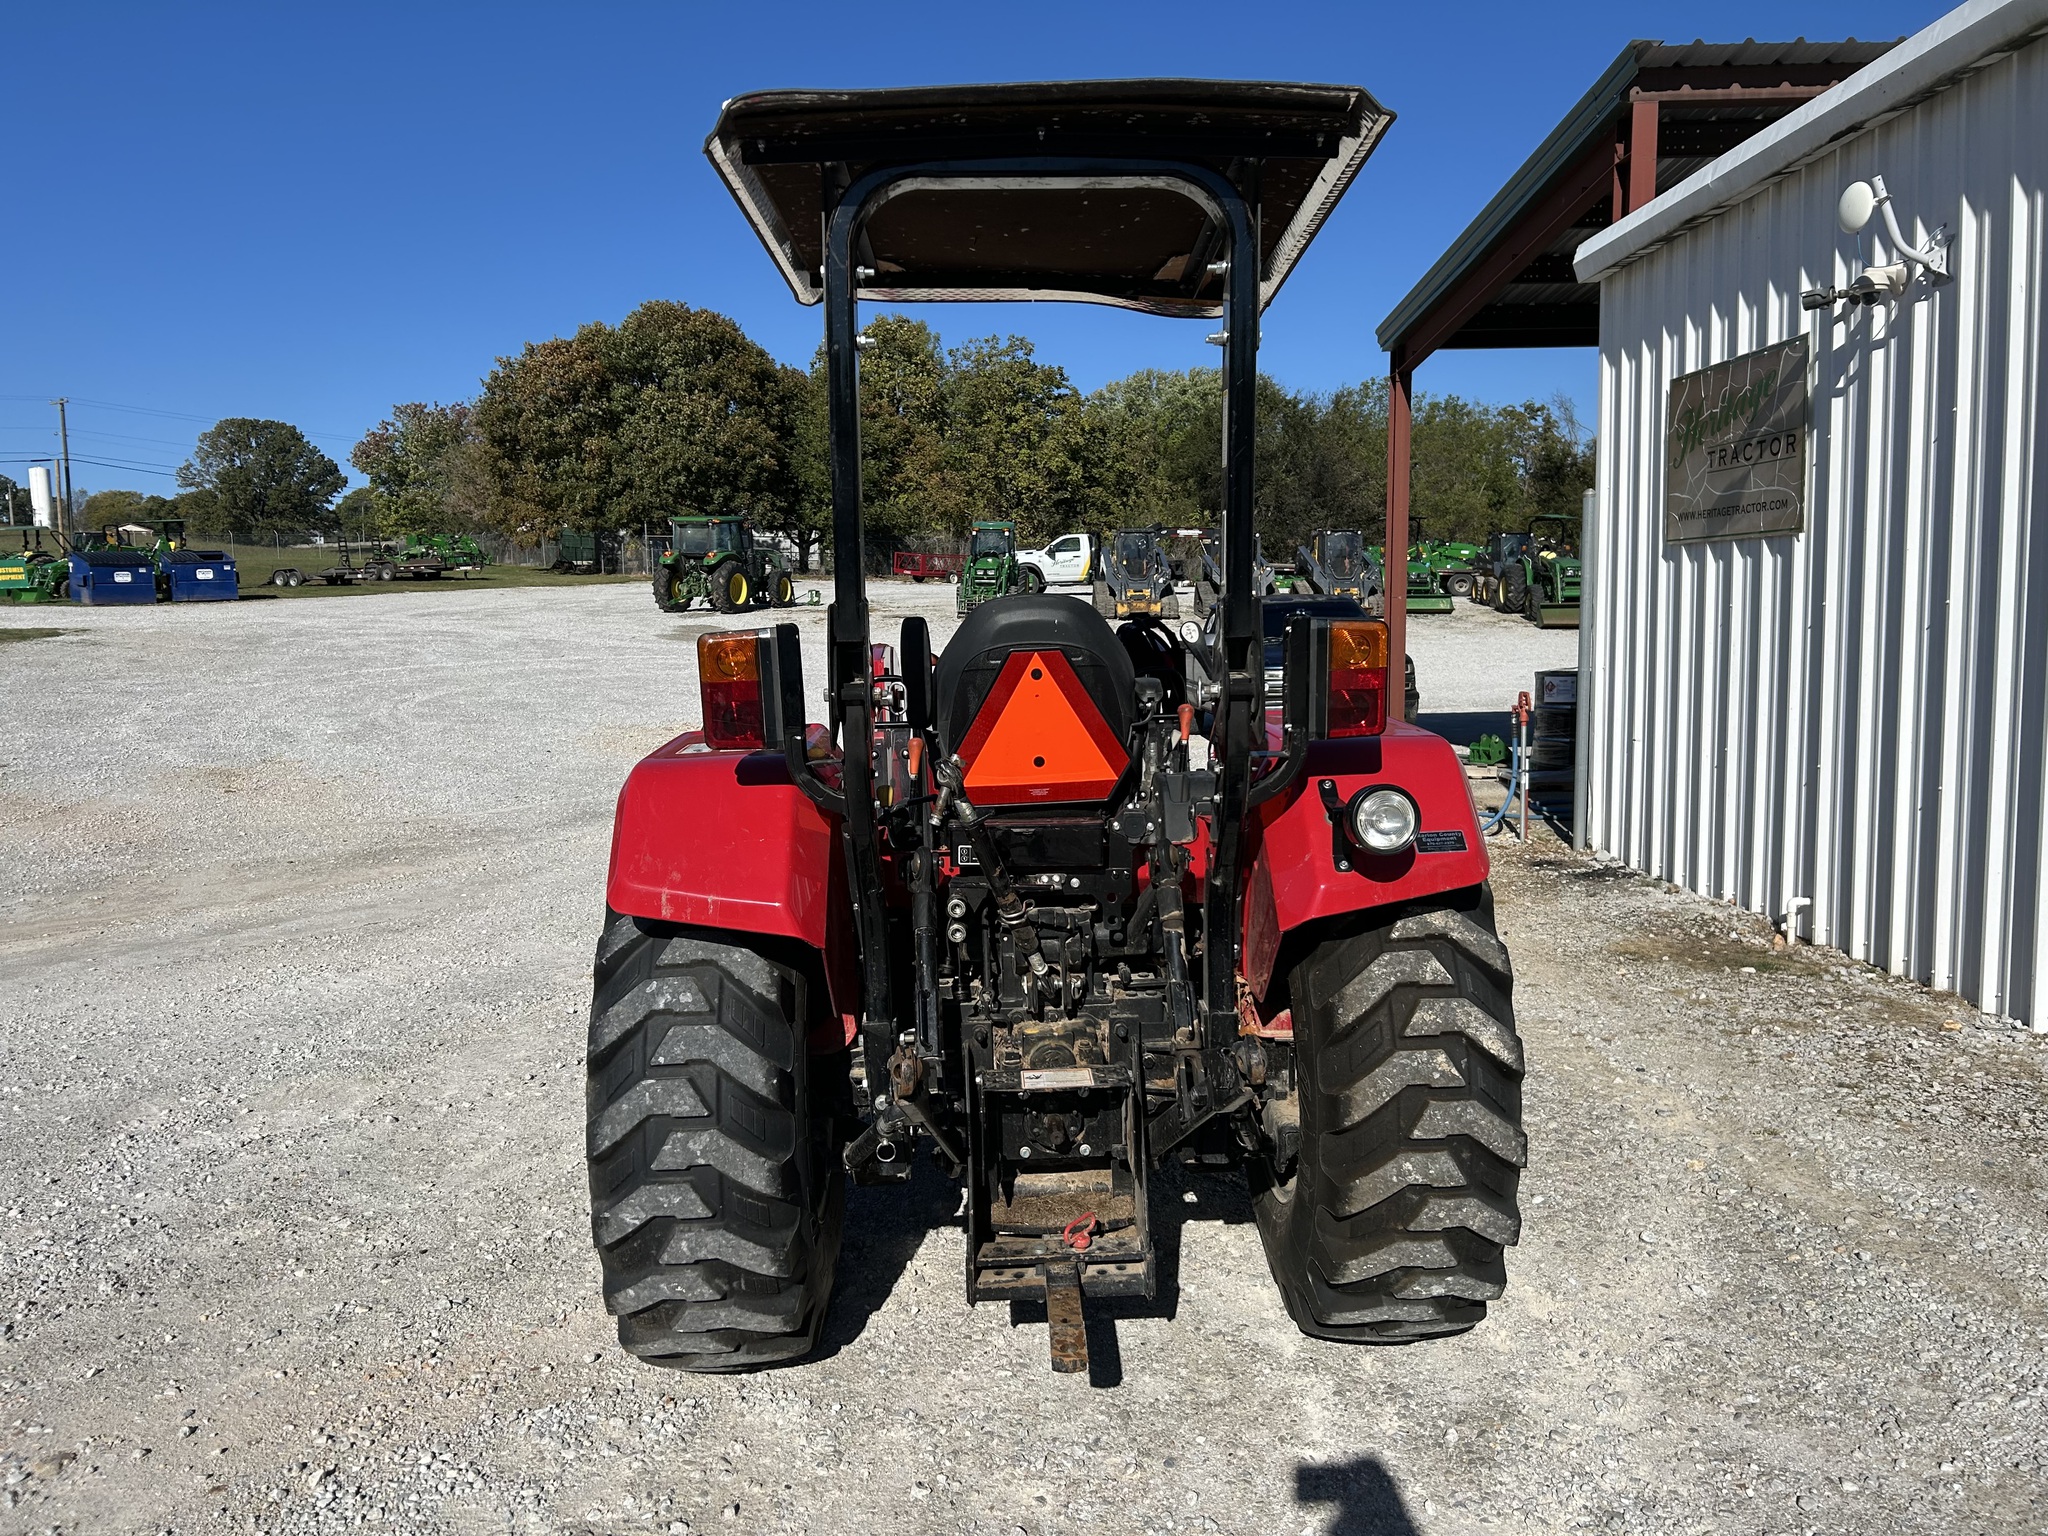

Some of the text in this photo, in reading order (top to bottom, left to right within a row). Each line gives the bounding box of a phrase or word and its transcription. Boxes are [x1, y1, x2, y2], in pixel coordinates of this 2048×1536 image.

[1673, 370, 1777, 469] Heritage
[1707, 433, 1797, 468] TRACTOR
[1679, 499, 1788, 522] WWW.HERITAGETRACTOR.COM
